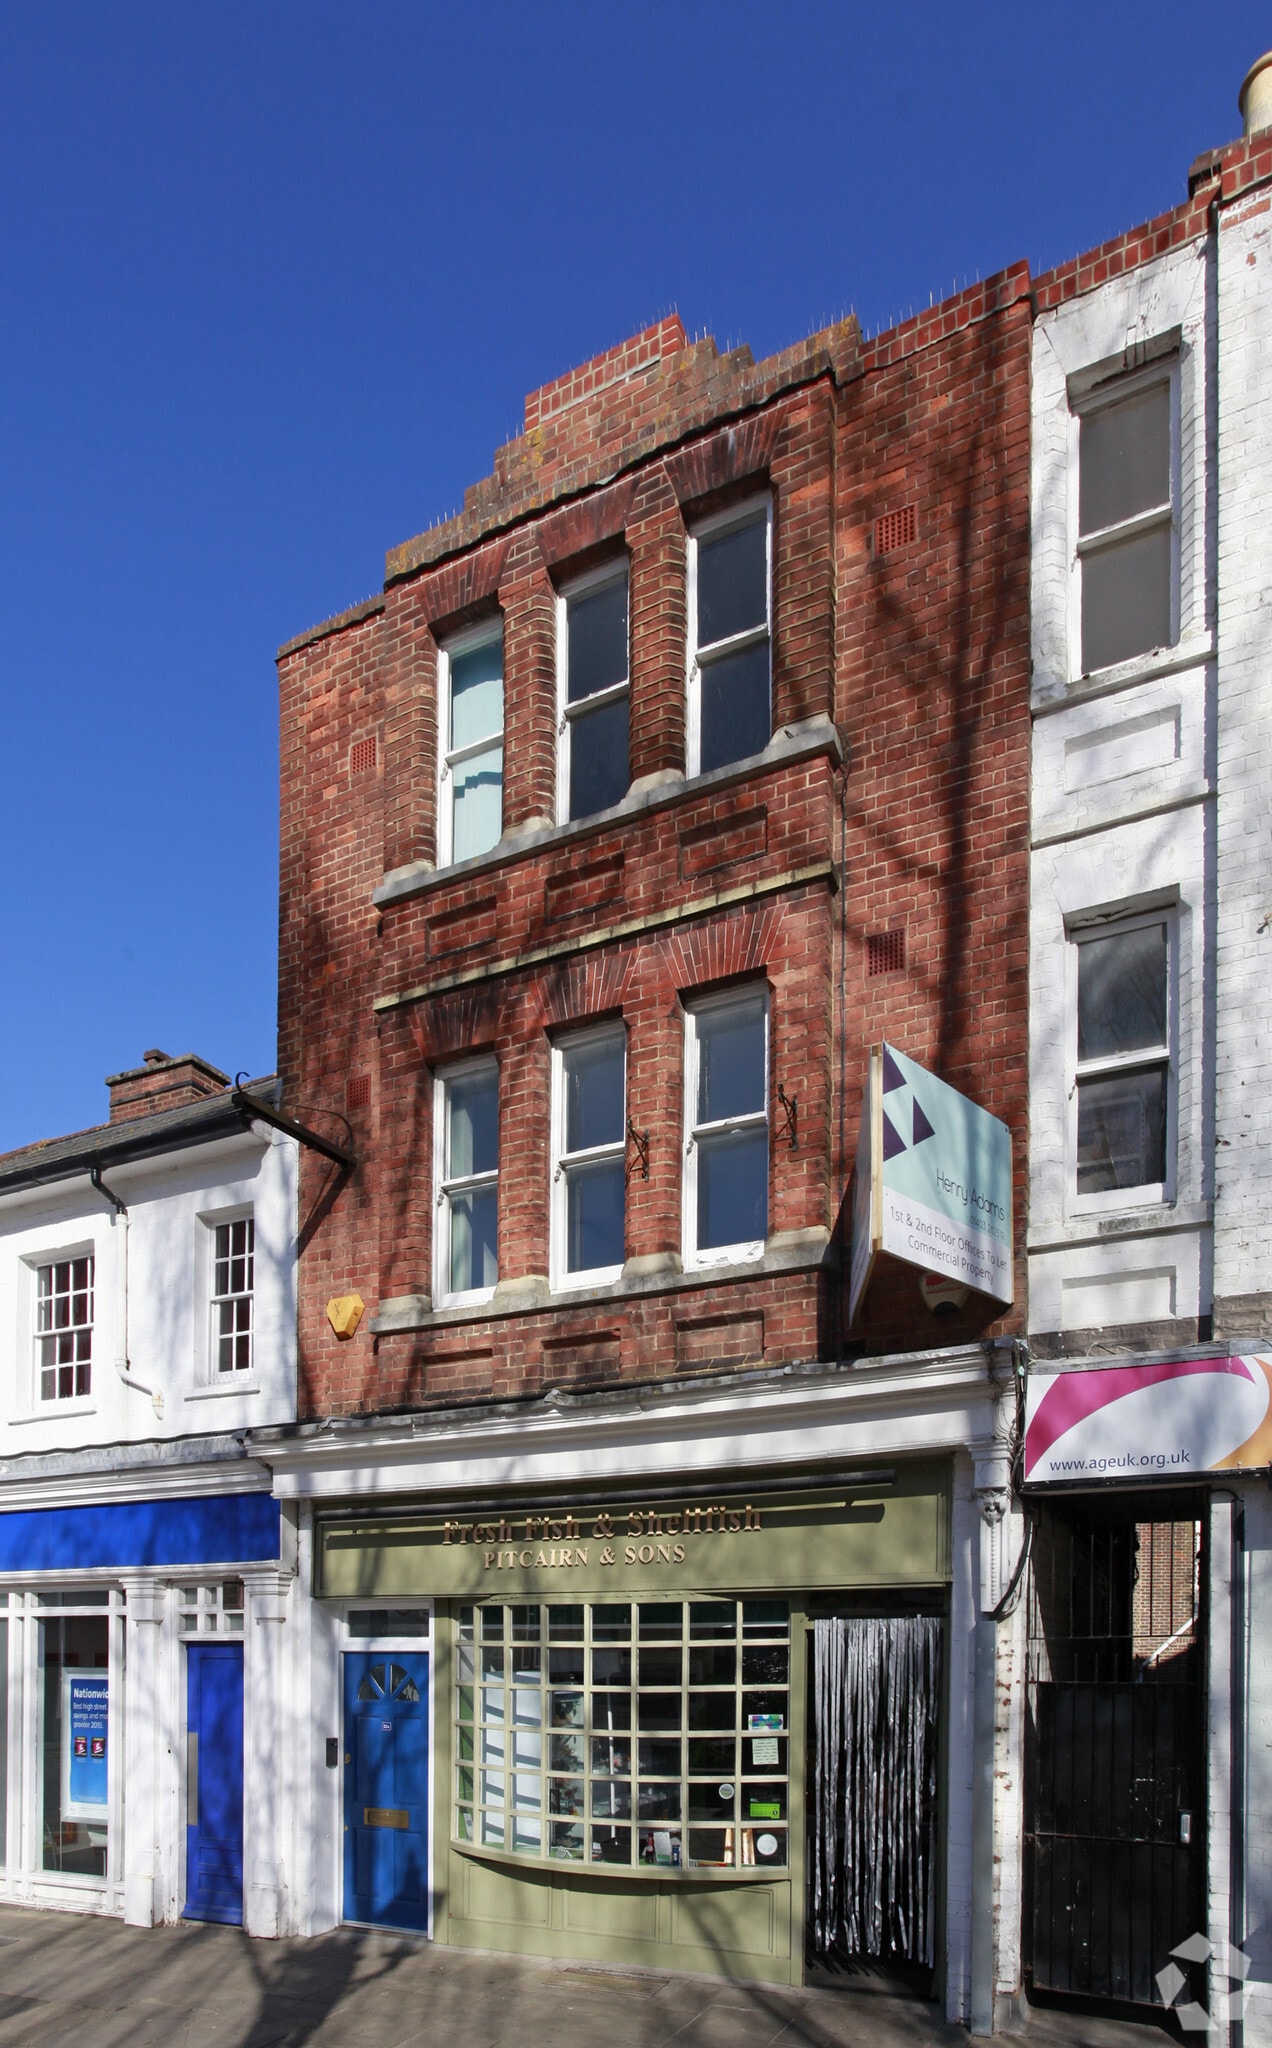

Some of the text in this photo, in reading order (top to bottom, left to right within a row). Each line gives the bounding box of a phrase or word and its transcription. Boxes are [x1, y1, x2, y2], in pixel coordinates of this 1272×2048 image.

[936, 1167, 1005, 1221] Henry Adams
[890, 1206, 1008, 1271] 1st & 2nd Floor Offices To Let
[907, 1234, 995, 1285] Commercial Property
[1050, 1449, 1190, 1472] www.ageuk.org.uk
[442, 1504, 762, 1546] Fresh Fish & Shellfish
[484, 1543, 686, 1570] PITCAIRN & SONS
[73, 1702, 82, 1710] Best
[83, 1702, 93, 1711] high
[73, 1712, 88, 1720] savings
[73, 1721, 90, 1729] provider
